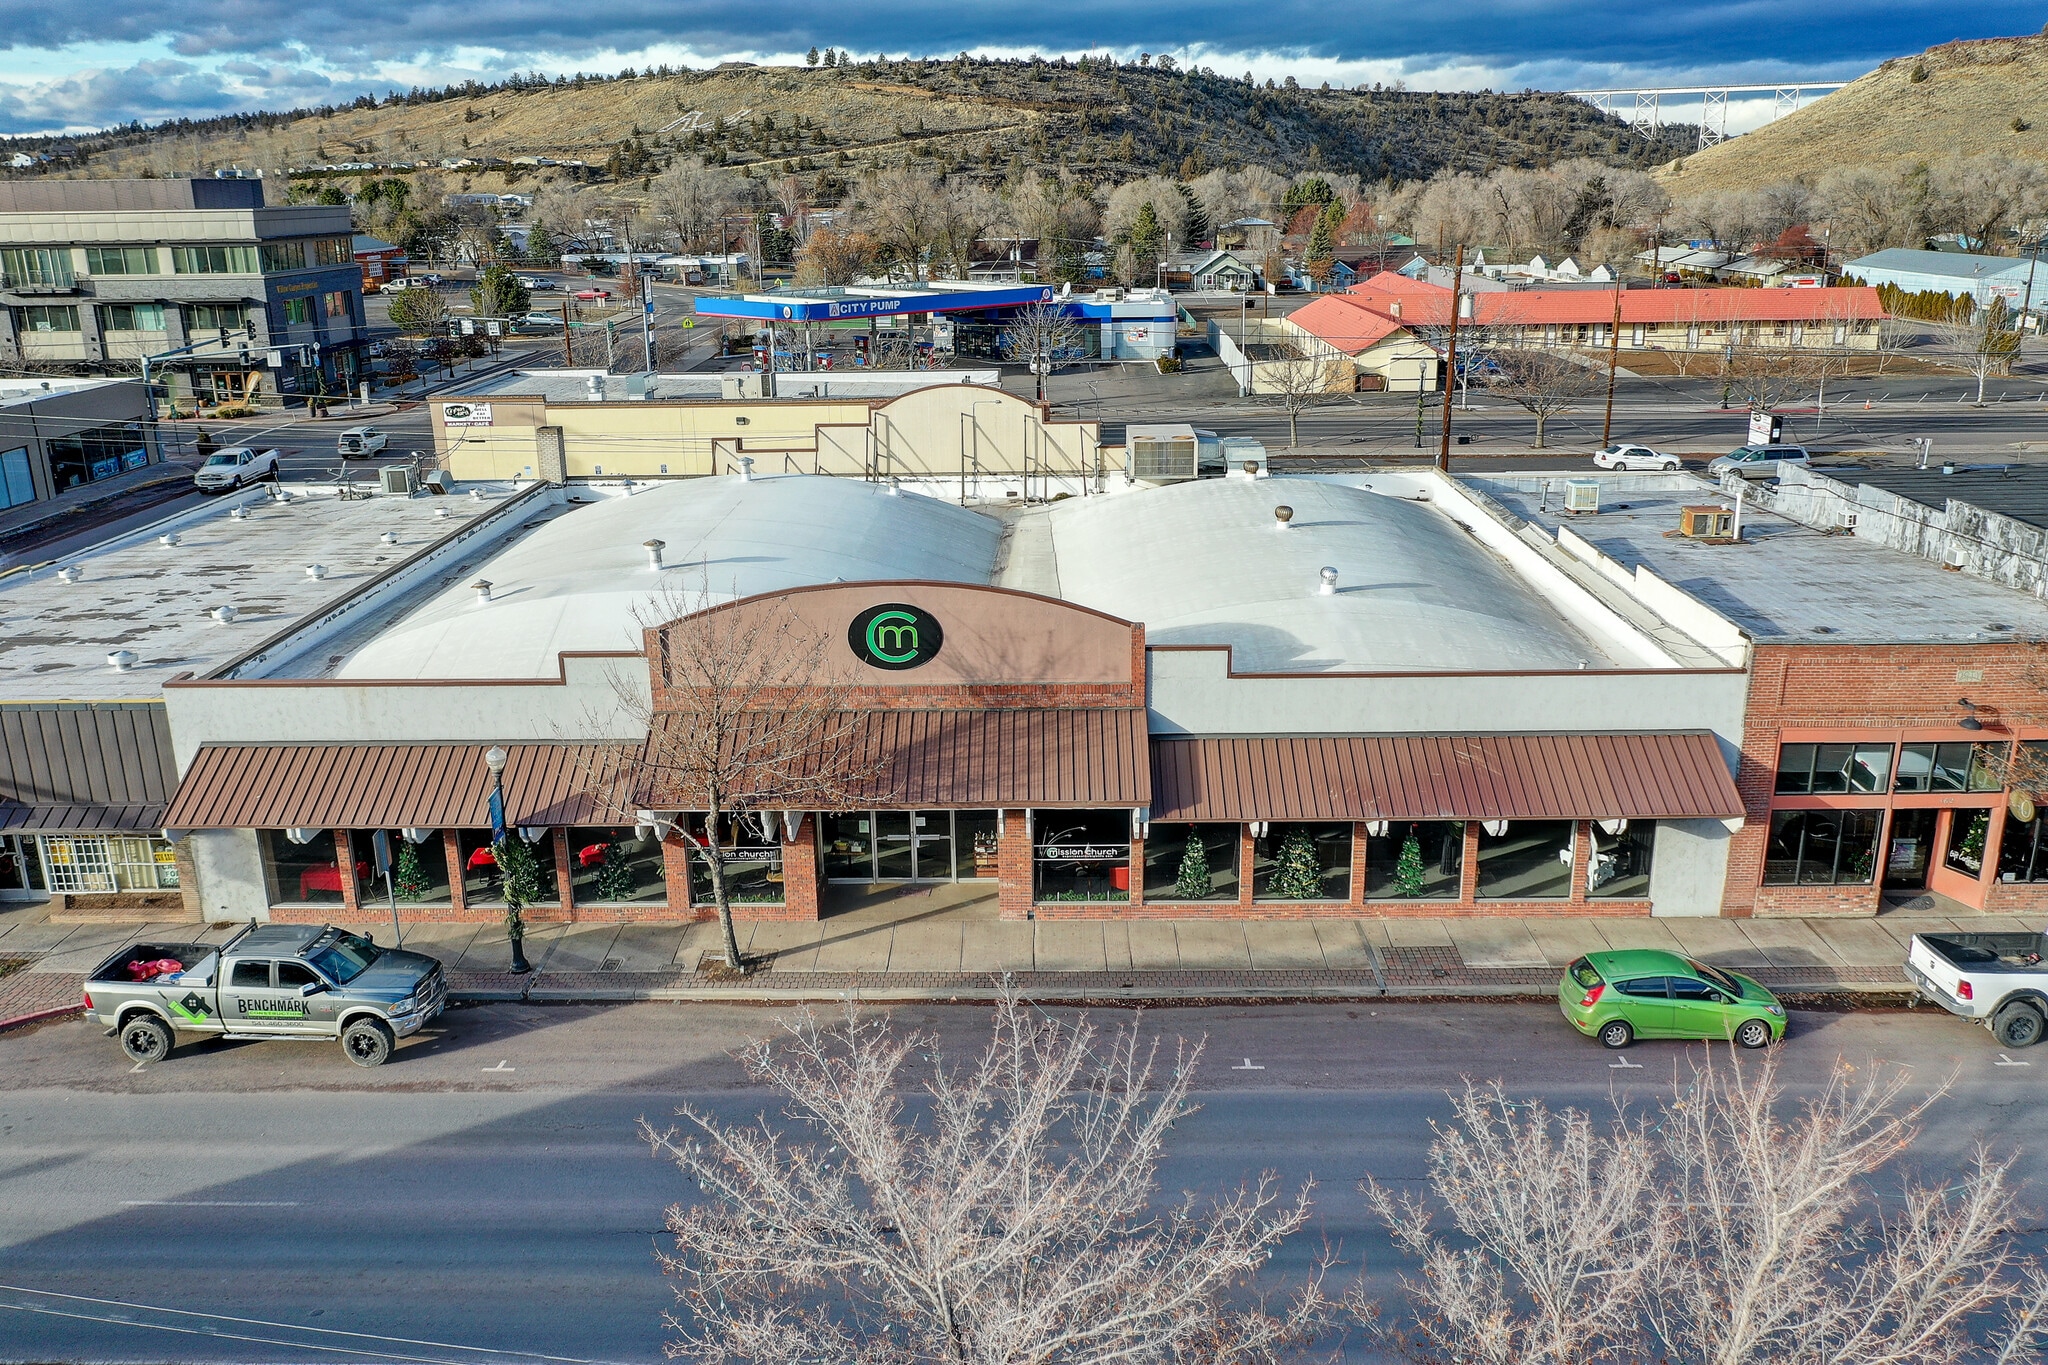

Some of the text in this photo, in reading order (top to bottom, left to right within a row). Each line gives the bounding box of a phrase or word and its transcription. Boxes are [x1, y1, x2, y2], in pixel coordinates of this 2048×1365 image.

[840, 300, 901, 314] CITY PUMP
[738, 850, 770, 858] church
[1084, 847, 1118, 856] church
[238, 999, 311, 1015] BENCHMARK
